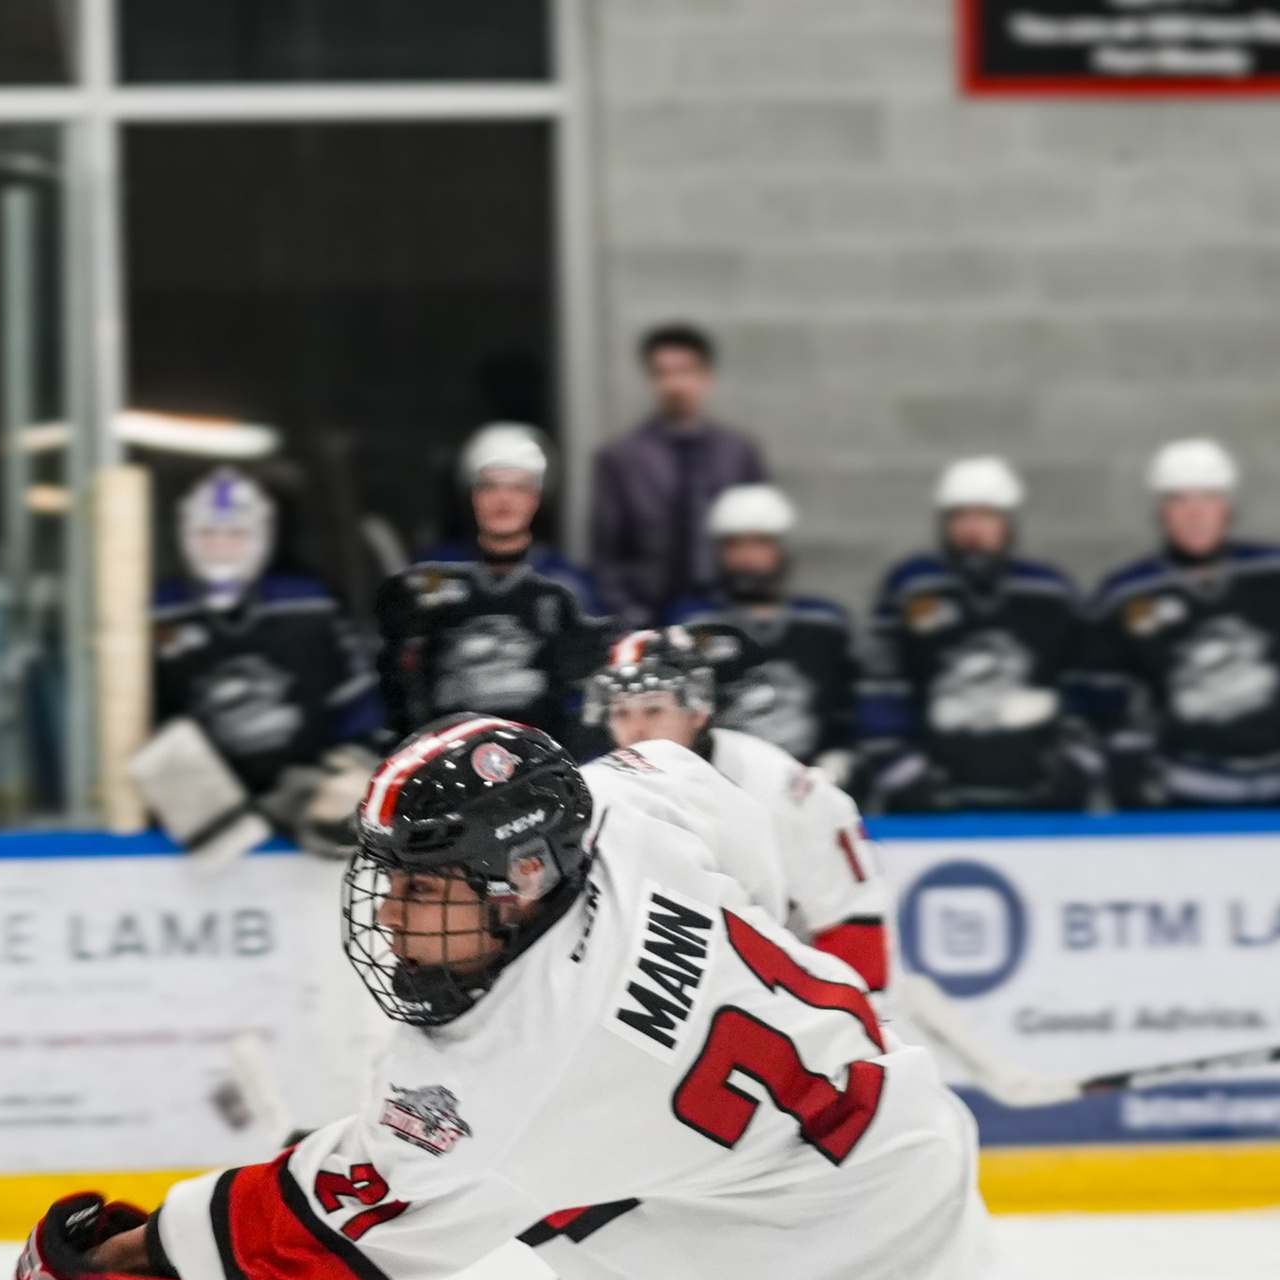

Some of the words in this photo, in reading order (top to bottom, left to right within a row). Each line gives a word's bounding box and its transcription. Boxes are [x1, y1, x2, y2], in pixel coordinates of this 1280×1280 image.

[68, 908, 276, 961] LAMB
[1061, 901, 1200, 950] BTM
[616, 891, 715, 1051] MANN
[670, 905, 888, 1167] 21
[313, 1162, 411, 1243] 21
